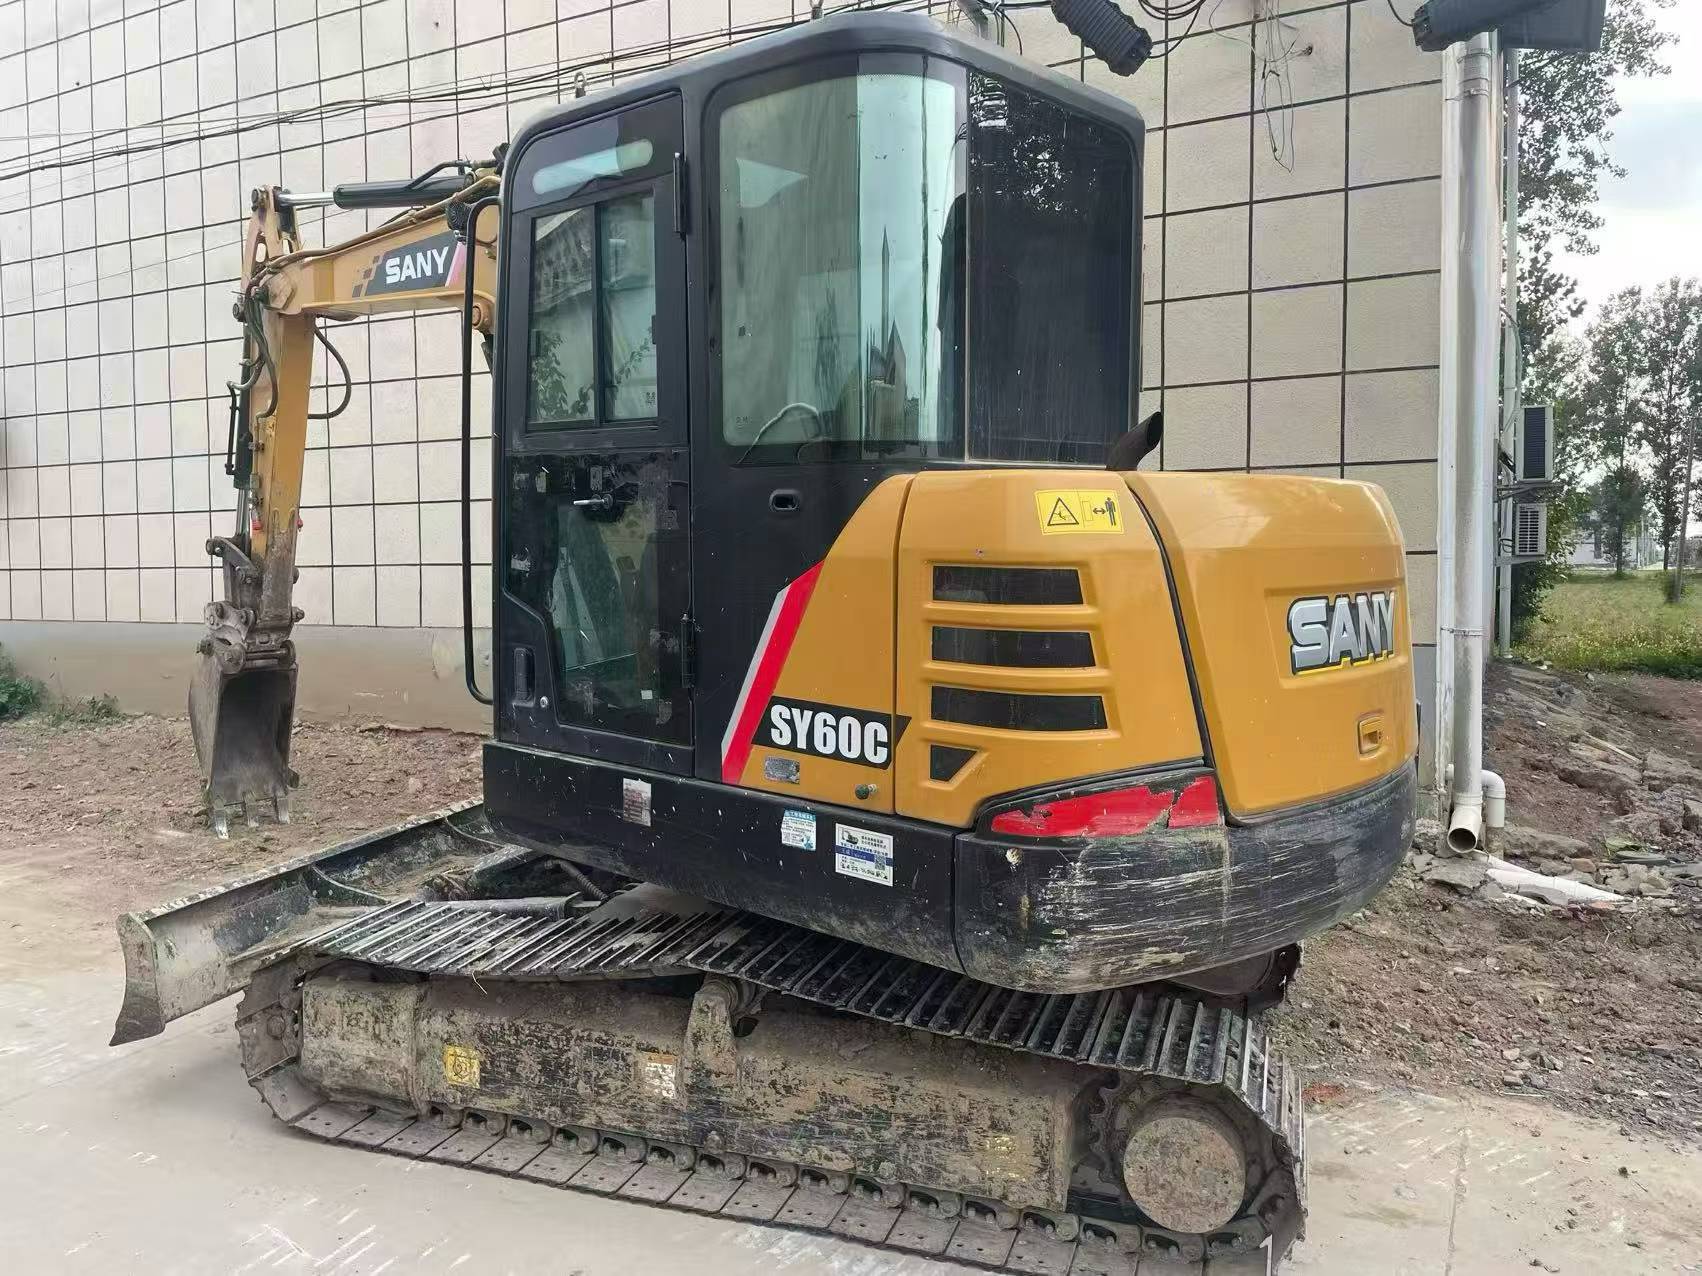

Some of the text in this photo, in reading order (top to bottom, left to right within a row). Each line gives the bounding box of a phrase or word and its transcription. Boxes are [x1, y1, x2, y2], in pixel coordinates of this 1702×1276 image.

[385, 246, 449, 284] SANY
[1288, 591, 1395, 674] SANY
[770, 704, 888, 764] SY60C
